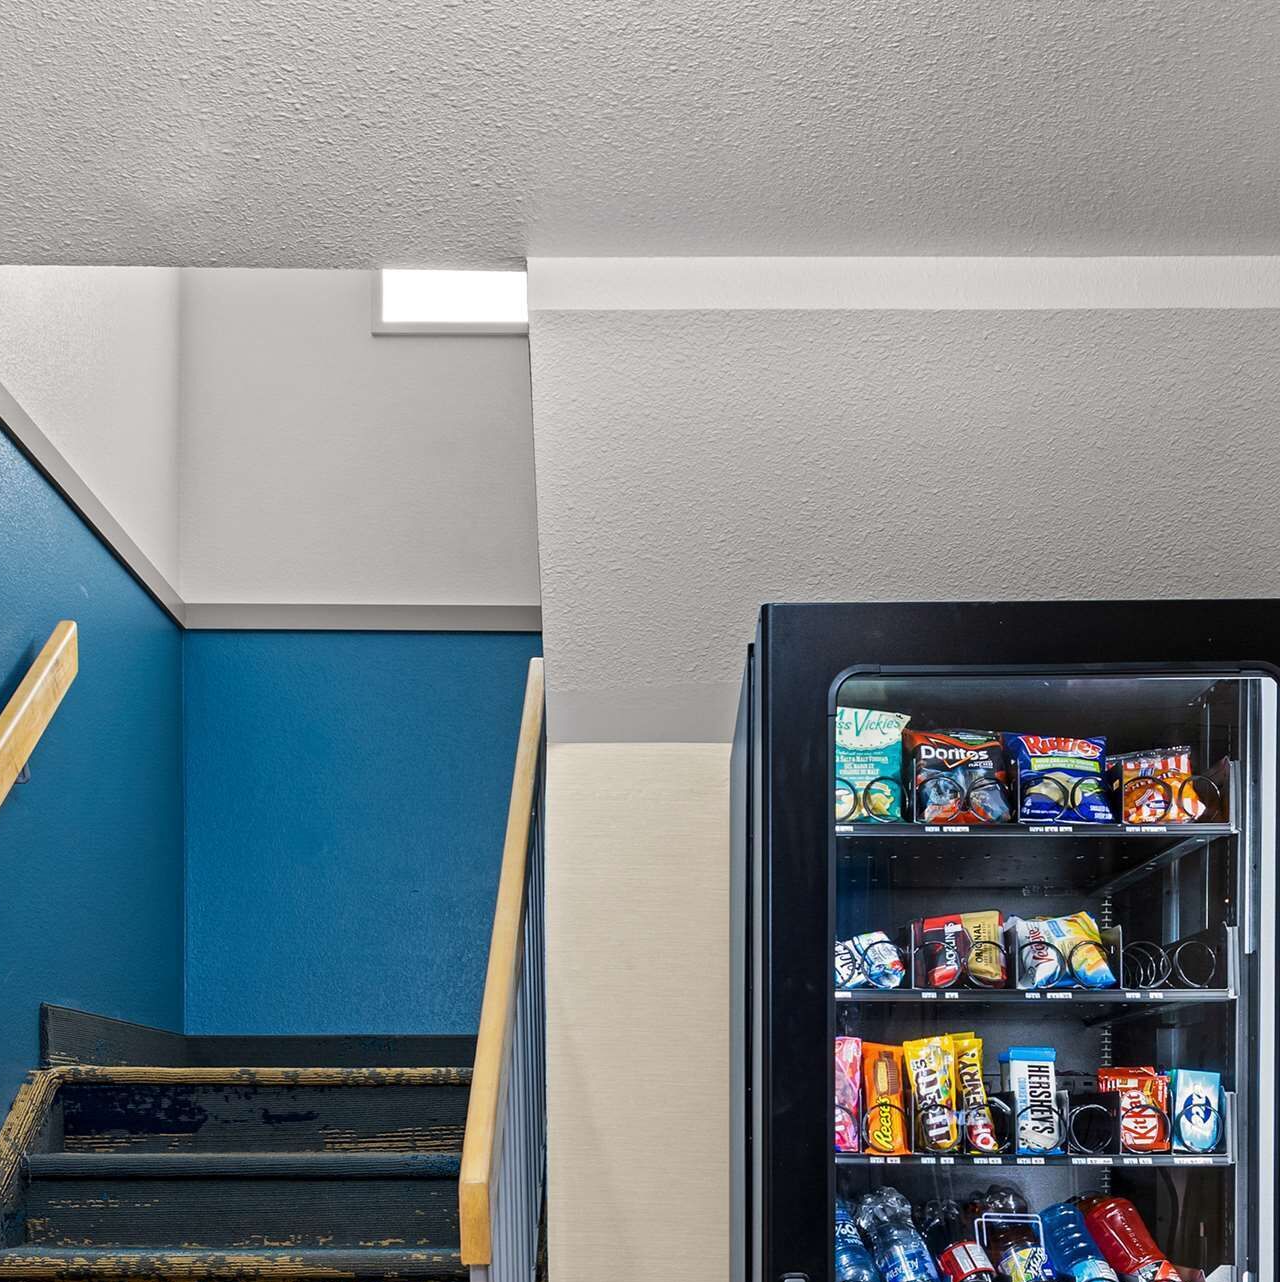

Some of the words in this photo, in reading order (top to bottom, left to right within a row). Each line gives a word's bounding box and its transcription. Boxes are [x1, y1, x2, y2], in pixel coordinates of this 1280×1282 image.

[920, 745, 989, 760] Doritos
[944, 922, 957, 946] LINS
[973, 923, 983, 963] ORIGNAL
[1027, 1065, 1054, 1134] HERSHEY'S
